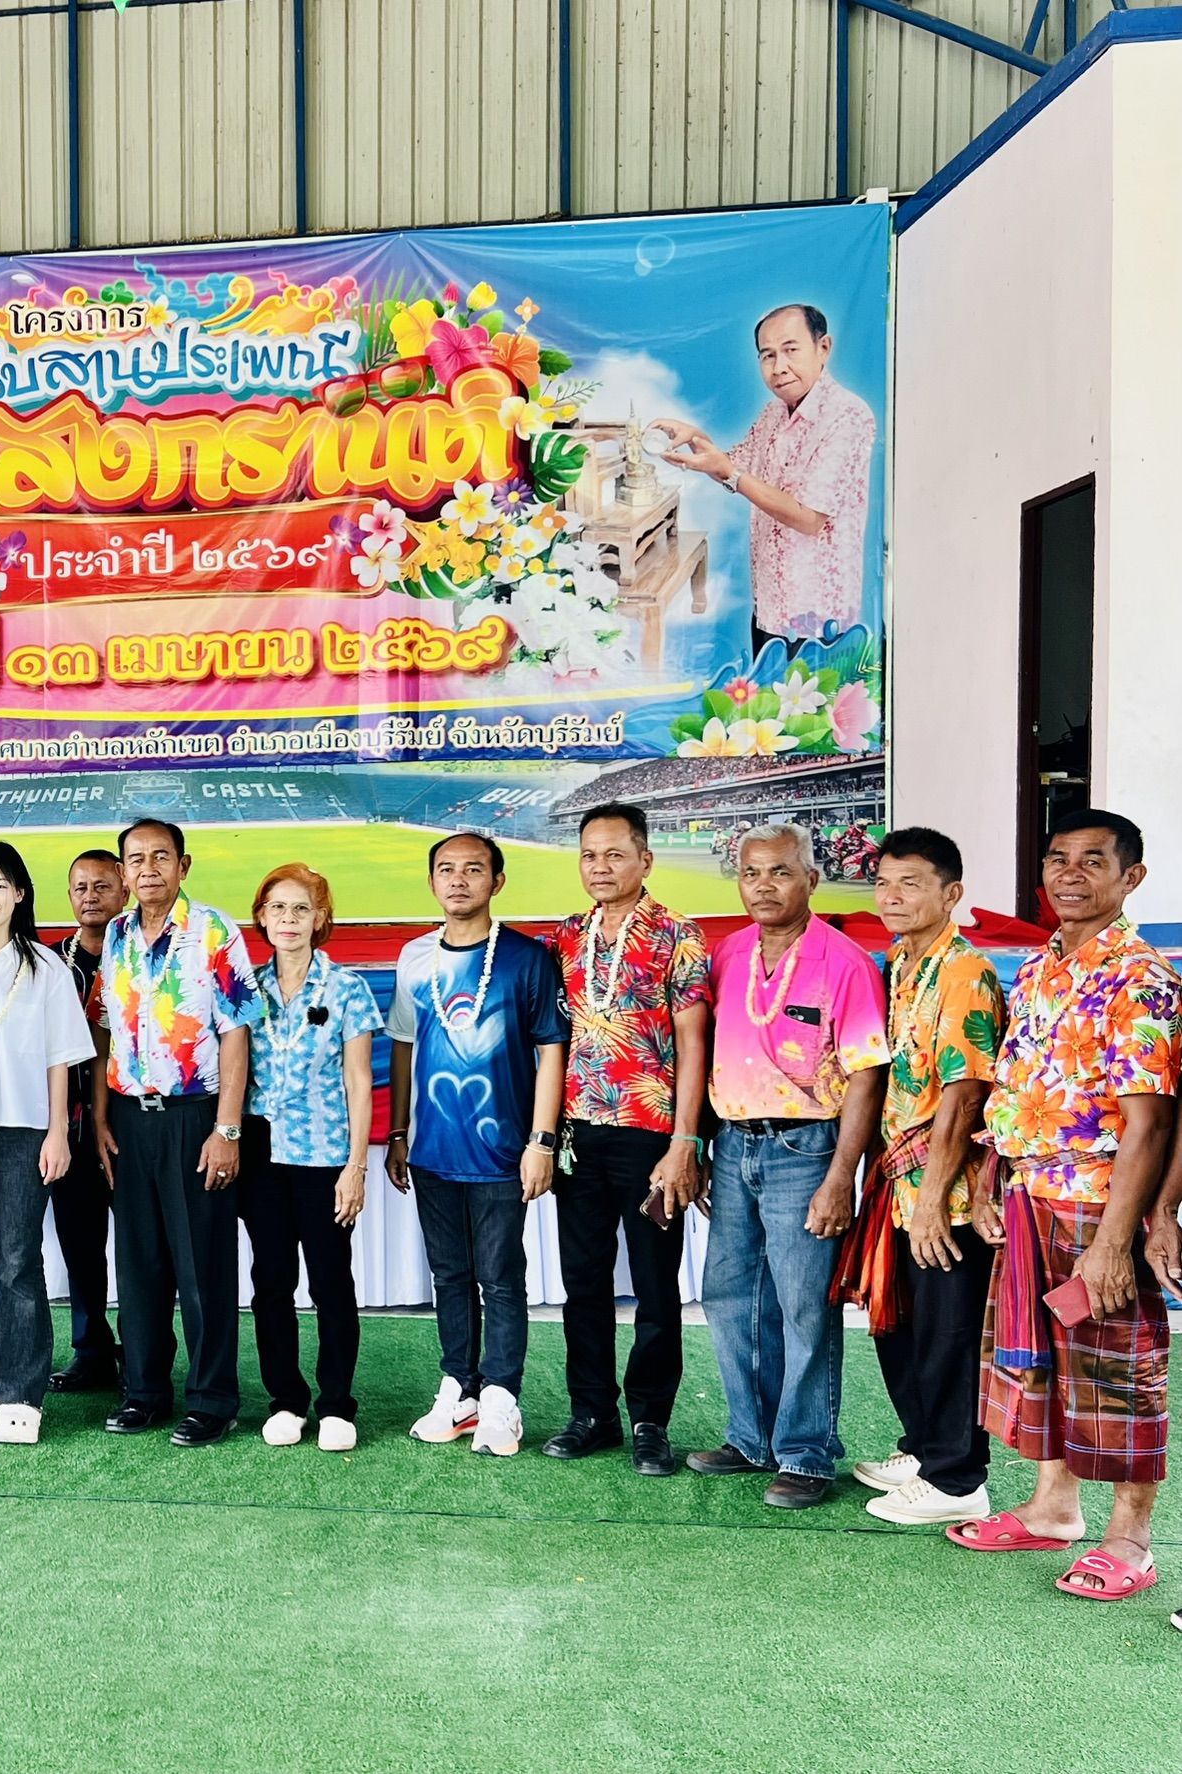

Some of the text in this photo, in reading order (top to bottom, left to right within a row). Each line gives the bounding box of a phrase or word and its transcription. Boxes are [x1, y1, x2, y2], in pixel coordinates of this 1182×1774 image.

[8, 303, 146, 335] โครงการ
[19, 528, 334, 579] ประจำปี ๒๕๖๙
[9, 645, 95, 682] ๑๓
[110, 632, 308, 678] เมษายน
[325, 618, 504, 671] ๒๕๖๙
[228, 720, 446, 757] อำเภอเมืองบุรีรัมย์
[449, 715, 622, 755] จังหวัดบุรีรัมย์
[201, 782, 303, 799] CASTLE
